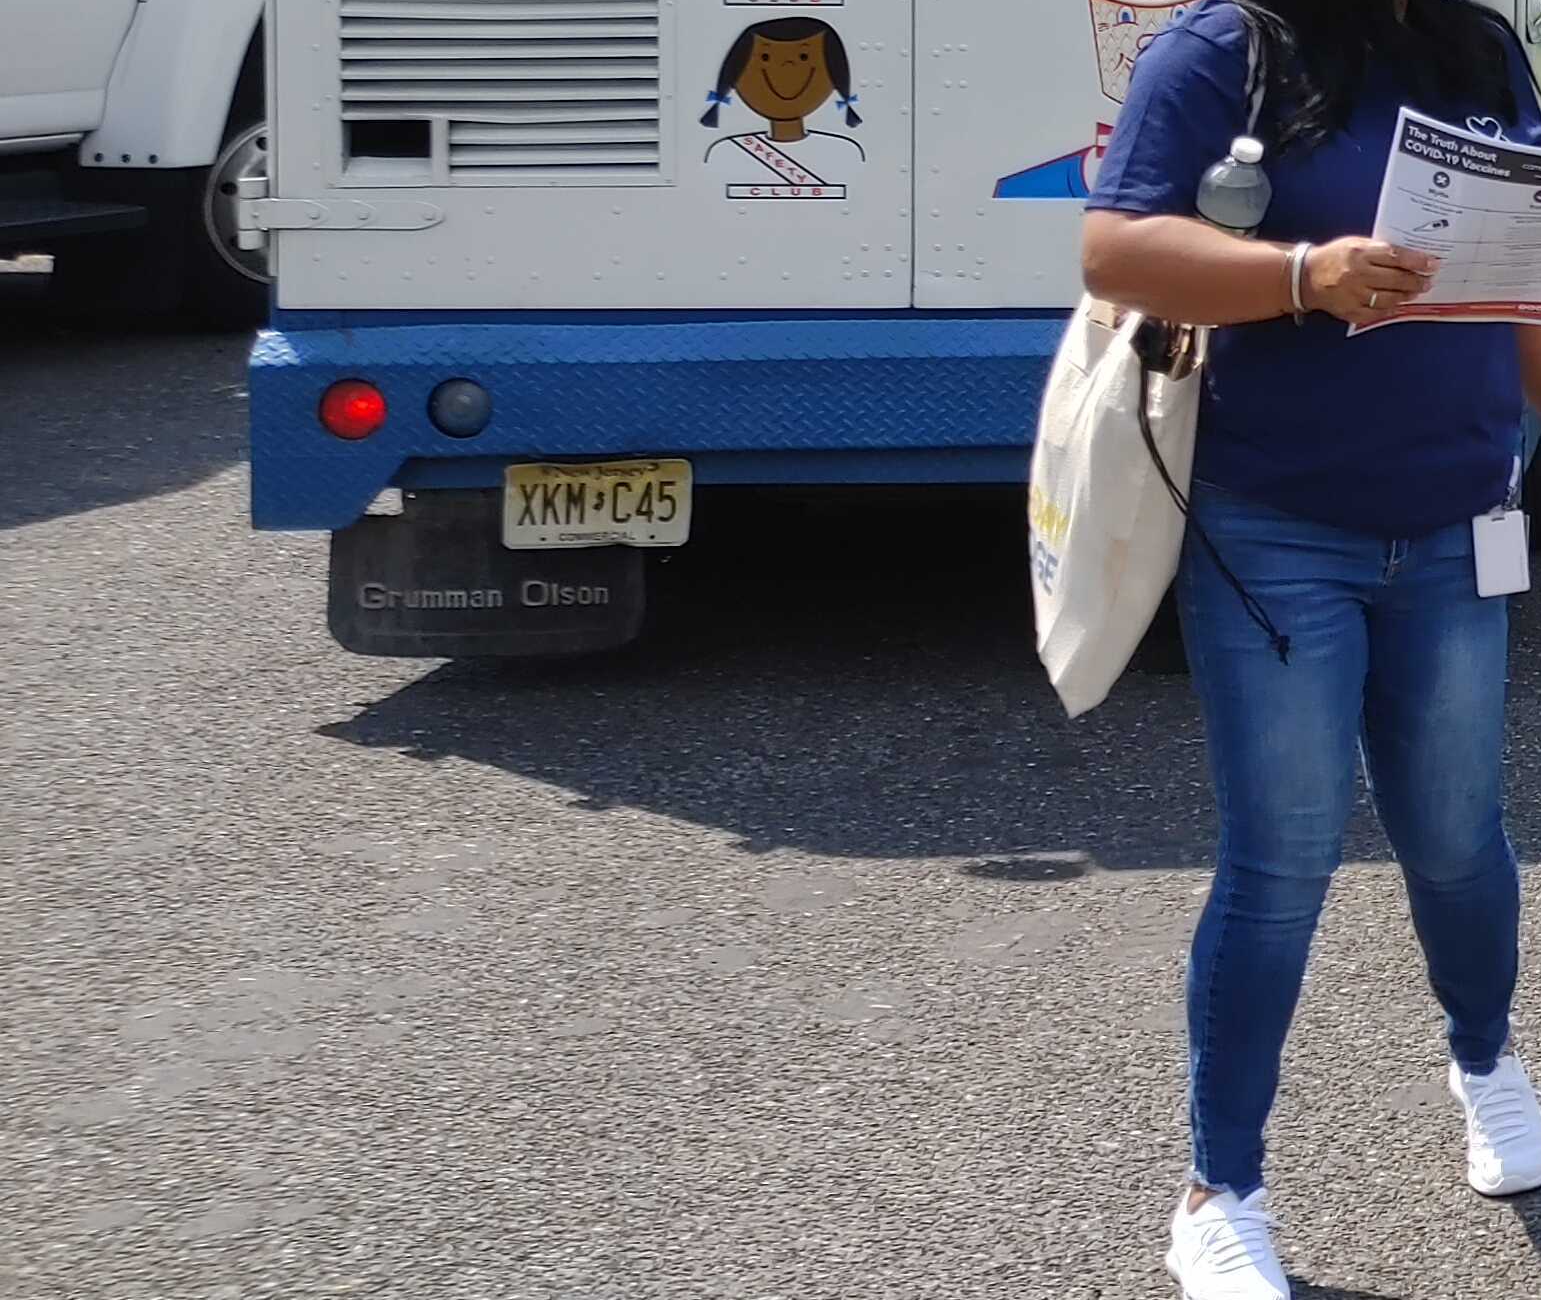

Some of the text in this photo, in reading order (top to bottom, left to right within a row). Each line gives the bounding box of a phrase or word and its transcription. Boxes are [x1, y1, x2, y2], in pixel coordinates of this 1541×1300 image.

[743, 137, 807, 184] SAFETY
[1405, 139, 1512, 177] COVID-19 Vaccines
[1408, 125, 1498, 163] The Truth About
[749, 187, 823, 196] CLUB
[357, 580, 609, 610] Grumman Olson
